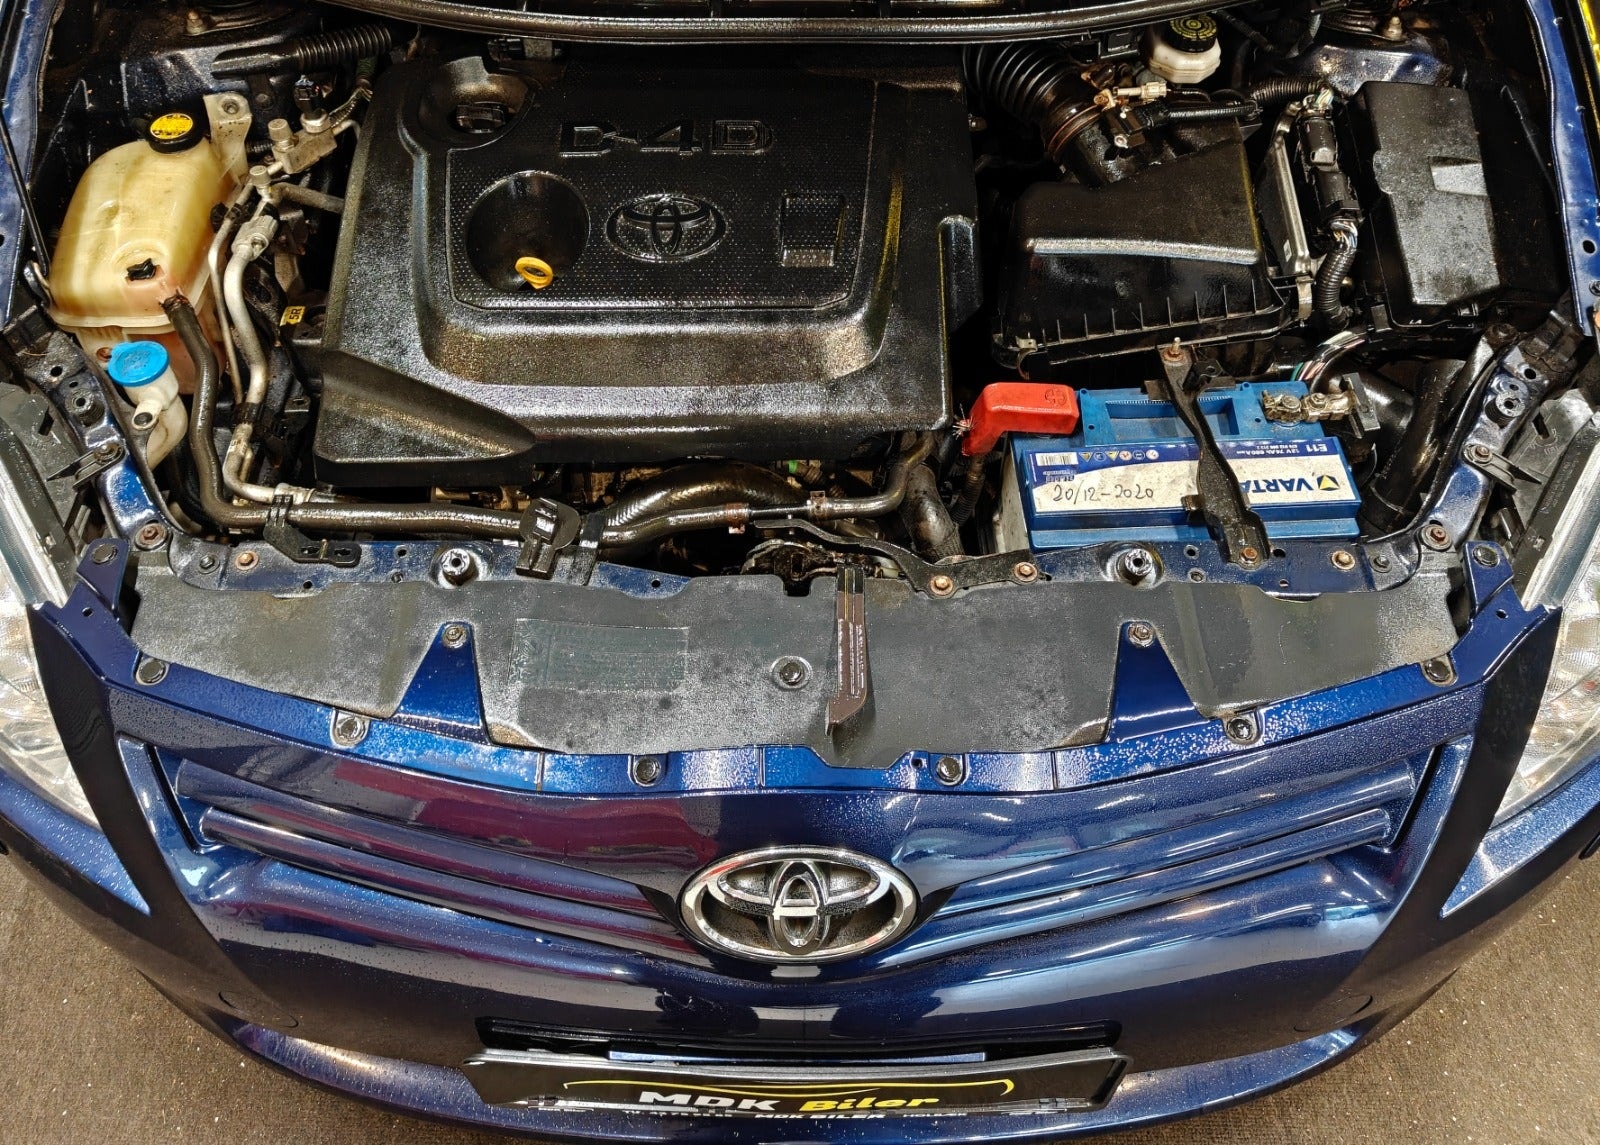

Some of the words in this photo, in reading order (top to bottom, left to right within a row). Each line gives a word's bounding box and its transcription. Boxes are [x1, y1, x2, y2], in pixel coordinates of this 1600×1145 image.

[559, 119, 774, 157] D-4D
[289, 307, 303, 320] 5R
[1305, 443, 1328, 453] E11
[1239, 478, 1314, 493] VARTA
[638, 1090, 781, 1111] MDK
[799, 1096, 940, 1112] Biler
